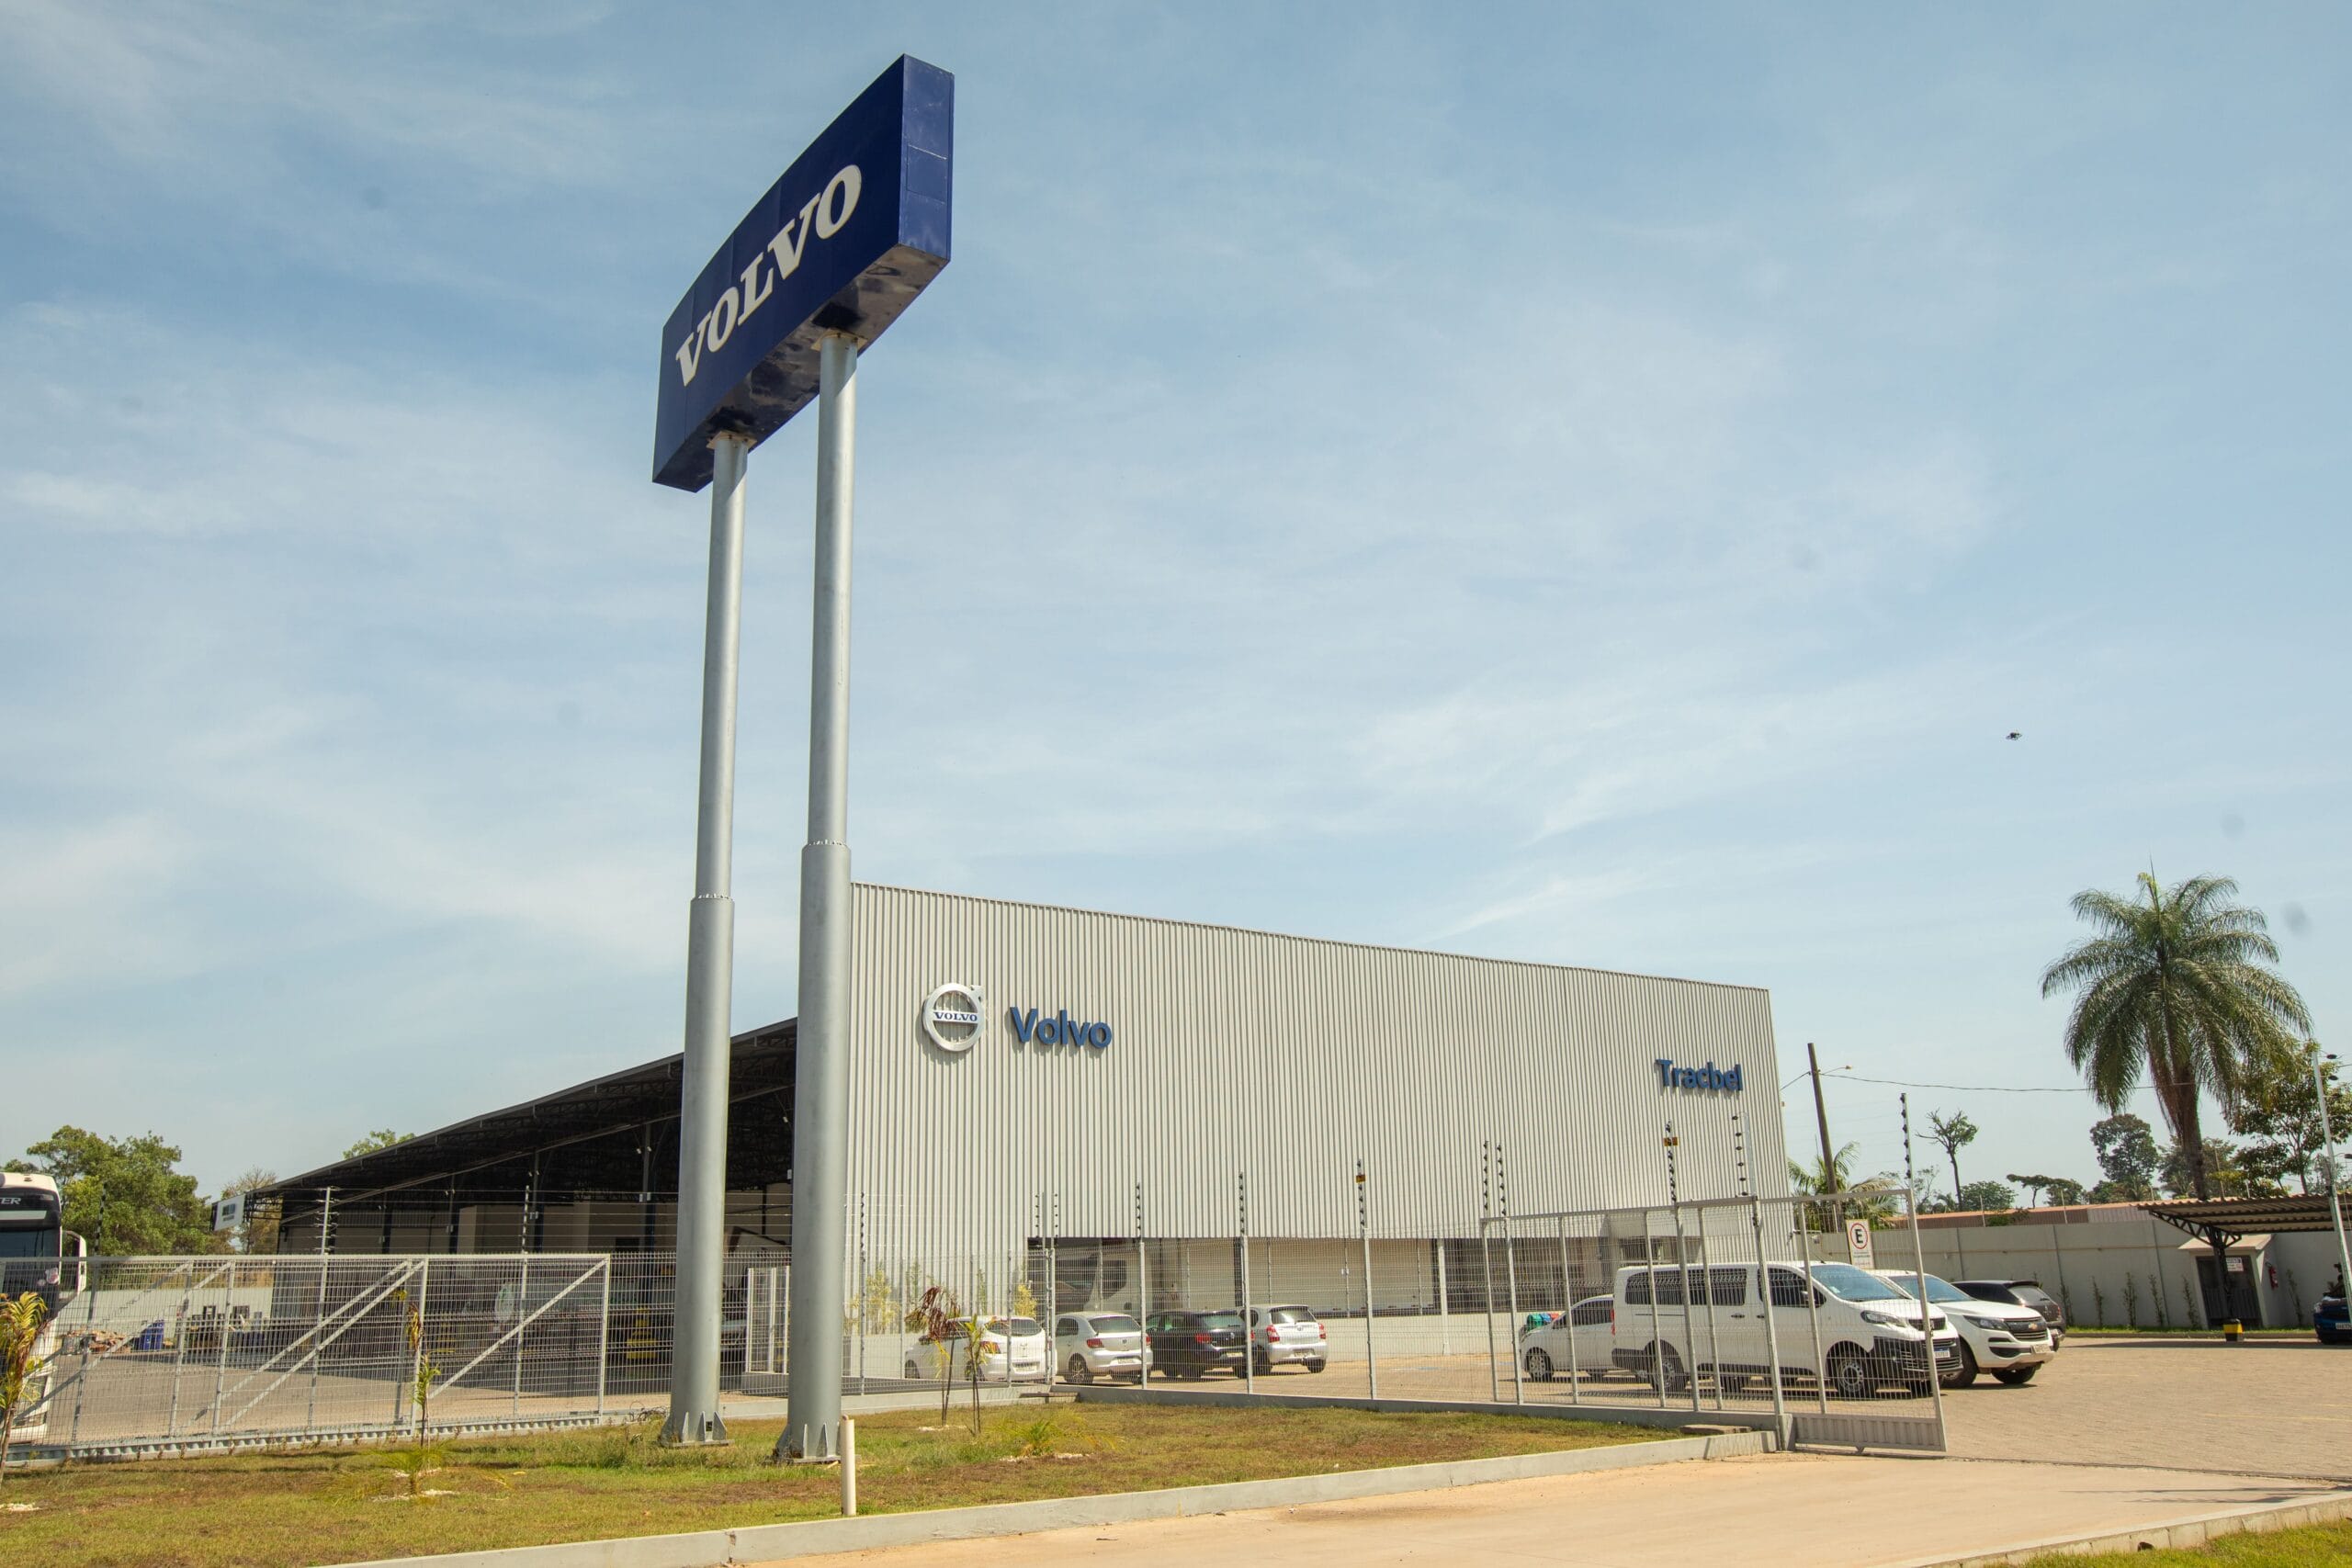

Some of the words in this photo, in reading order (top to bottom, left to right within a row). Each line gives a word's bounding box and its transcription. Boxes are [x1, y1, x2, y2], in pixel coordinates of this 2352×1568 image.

[675, 164, 862, 387] VOLVO
[933, 1011, 978, 1021] VOLVO
[1011, 1007, 1113, 1048] Volvo
[1655, 1058, 1743, 1091] Tracbel
[1855, 1228, 1863, 1244] E
